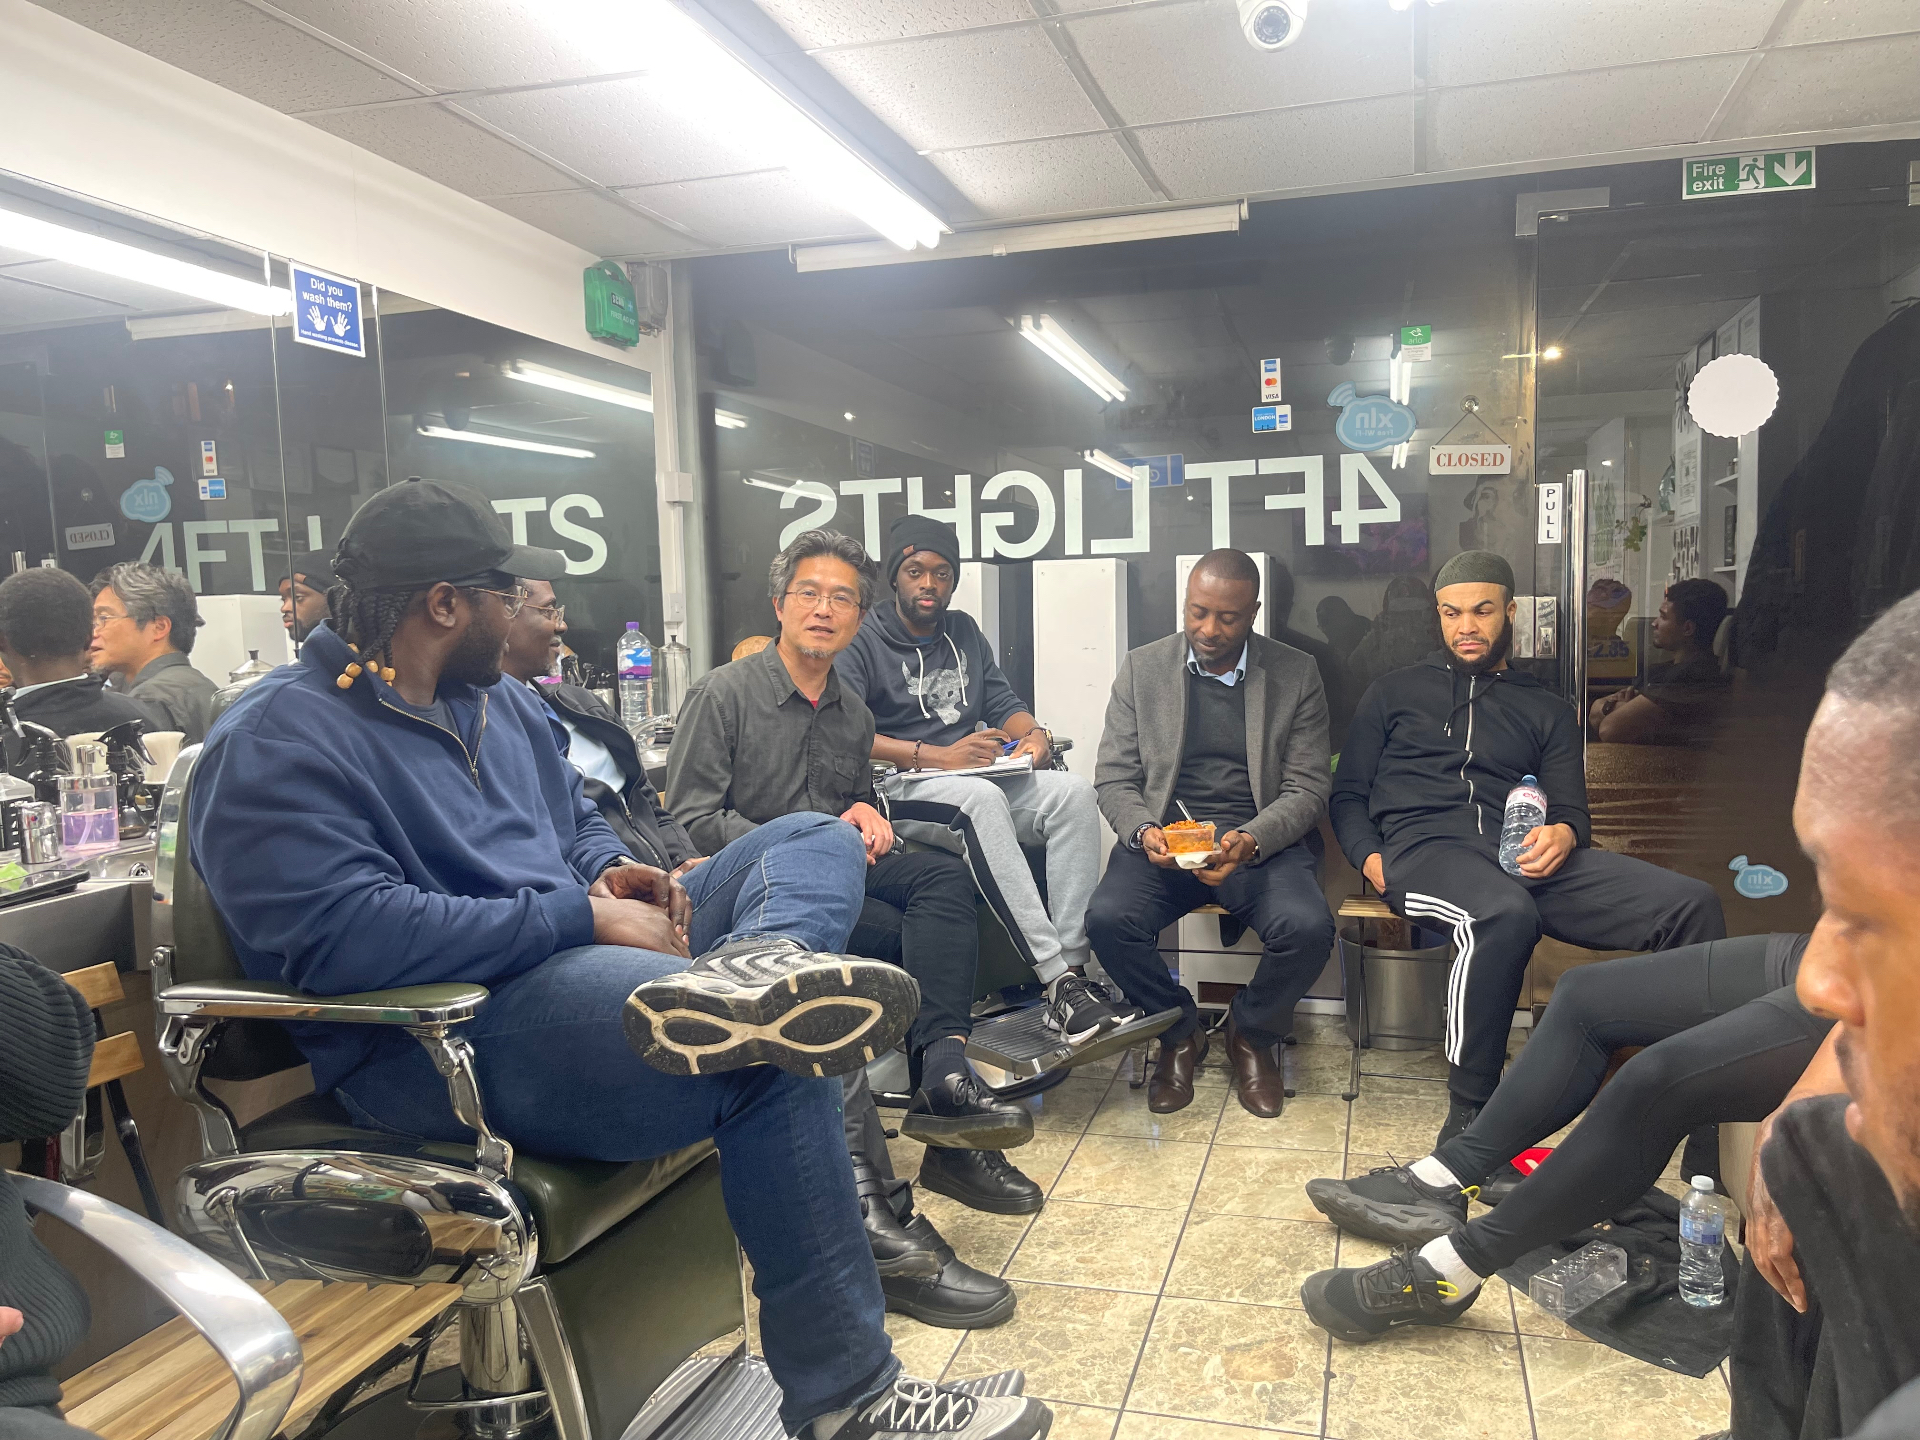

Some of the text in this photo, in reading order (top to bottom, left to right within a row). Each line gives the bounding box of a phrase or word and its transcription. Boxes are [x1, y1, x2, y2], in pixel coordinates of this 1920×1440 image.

[1692, 162, 1726, 178] Fire
[1692, 176, 1725, 192] exit
[310, 278, 343, 297] Did you
[302, 291, 353, 312] wash them?
[610, 310, 622, 321] FIRST
[1436, 452, 1505, 468] CLOSED
[1545, 488, 1556, 539] PULL
